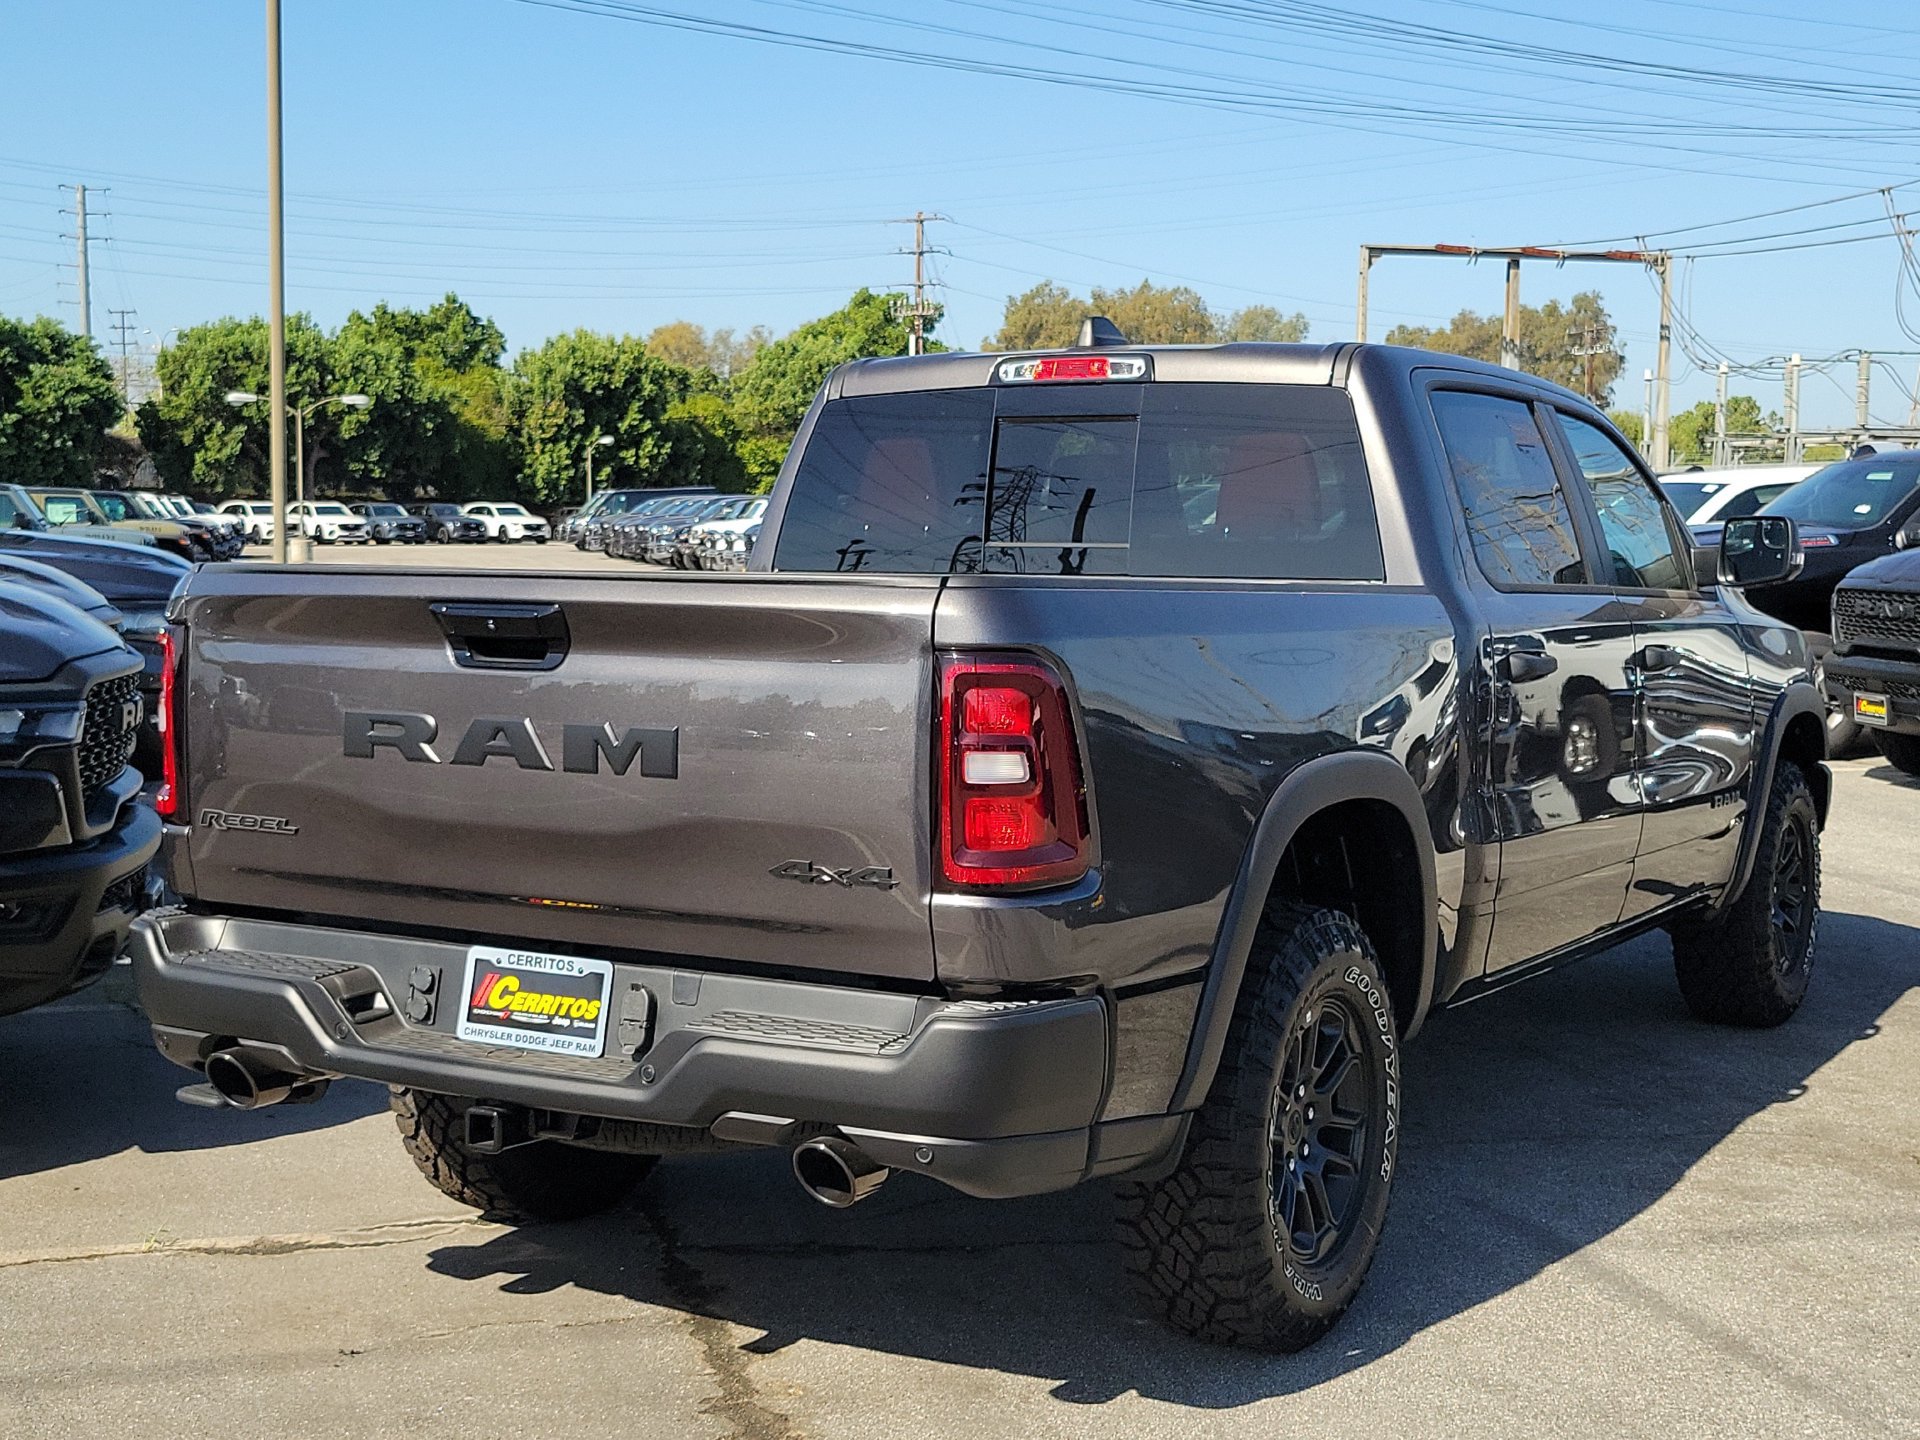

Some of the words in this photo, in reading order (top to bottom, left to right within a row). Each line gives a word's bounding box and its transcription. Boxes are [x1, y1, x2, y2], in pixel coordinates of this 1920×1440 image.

[343, 710, 679, 780] RAM
[200, 808, 300, 834] REBEL
[507, 953, 575, 972] CERRITOS
[488, 975, 602, 1020] CERRITOS
[464, 1026, 513, 1042] CHRYSLER
[515, 1033, 547, 1046] DODGE
[549, 1038, 574, 1050] JEEP
[575, 1043, 597, 1054] RAM
[1344, 966, 1397, 1183] GOODYEAR
